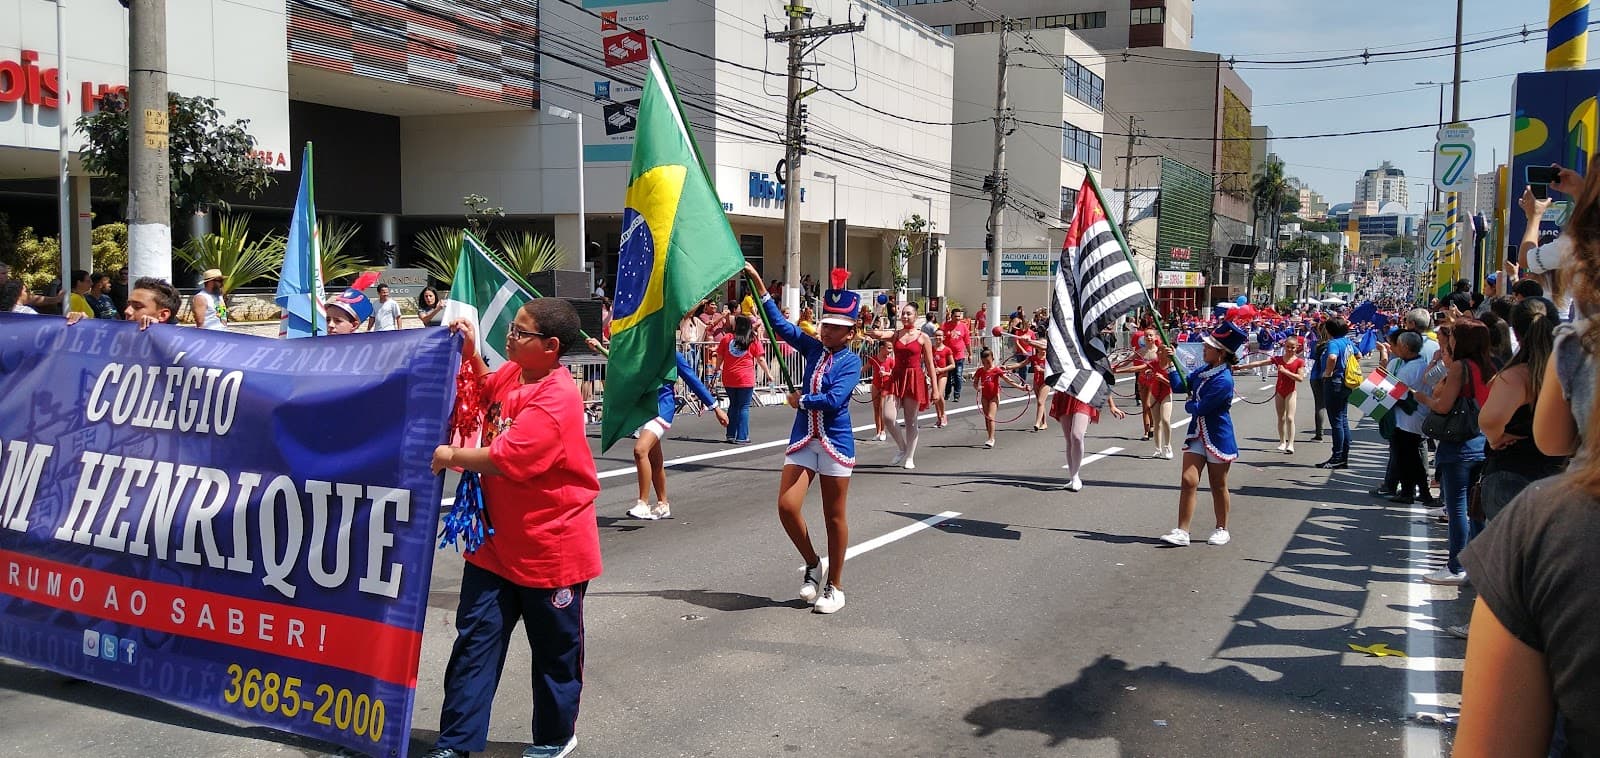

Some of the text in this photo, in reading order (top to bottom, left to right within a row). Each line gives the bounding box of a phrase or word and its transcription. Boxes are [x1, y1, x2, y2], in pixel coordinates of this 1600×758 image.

[276, 152, 287, 167] A
[87, 352, 245, 436] COLÉGIO
[0, 439, 411, 599] M HENRIQUE
[8, 562, 328, 652] RUMO AO SABER!
[223, 663, 386, 743] 3685-2000
